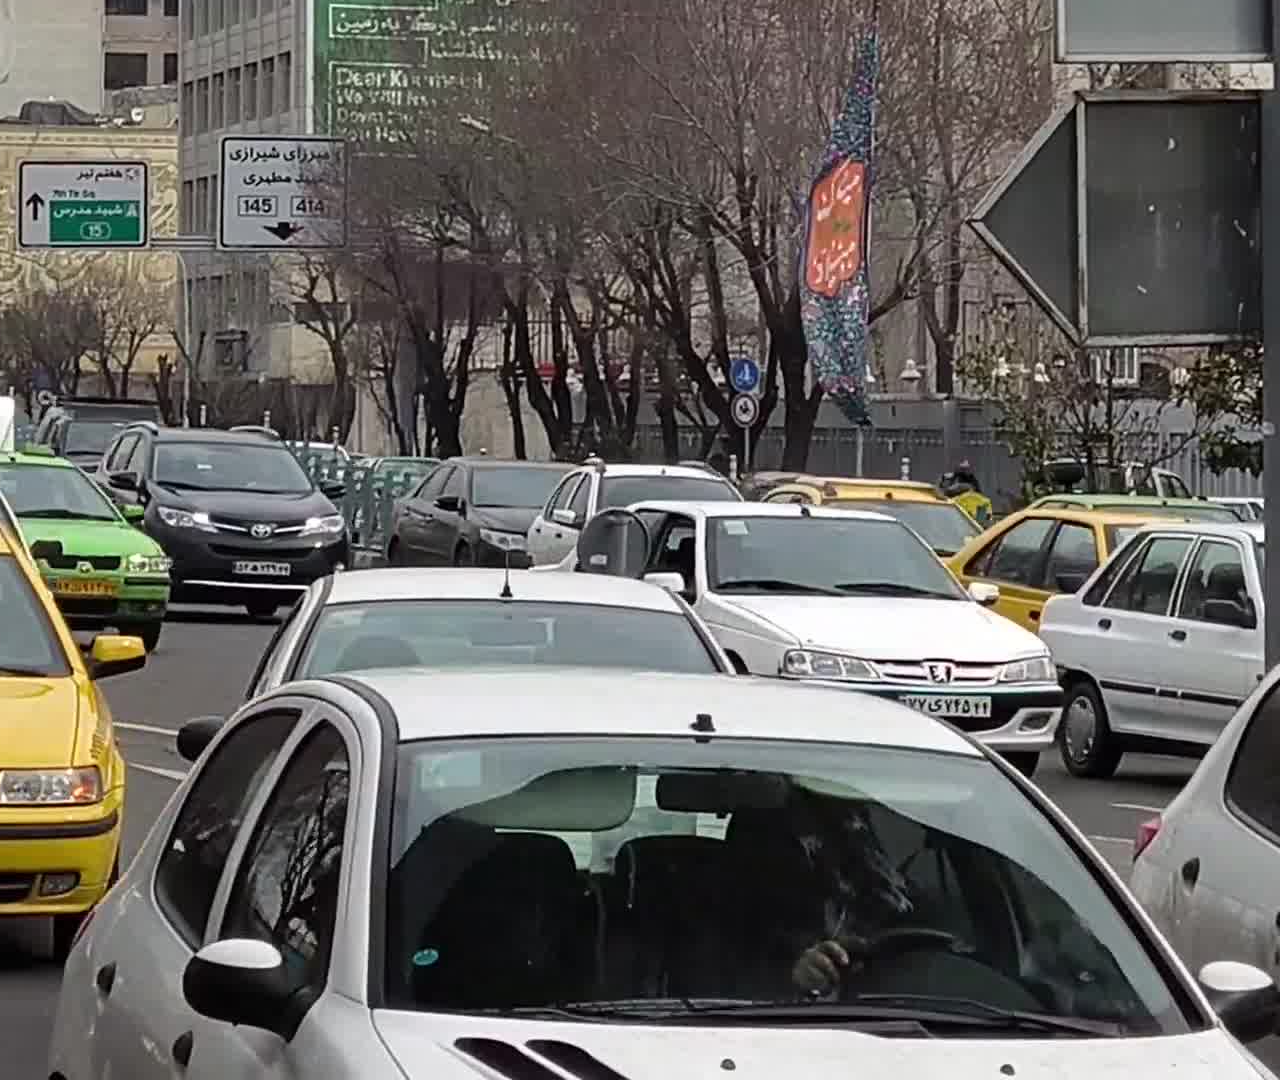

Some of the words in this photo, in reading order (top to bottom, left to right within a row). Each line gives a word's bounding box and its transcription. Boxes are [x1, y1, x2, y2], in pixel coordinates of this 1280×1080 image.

[229, 145, 281, 162] شیرازی
[243, 171, 293, 187] مطهری
[243, 198, 273, 213] 145
